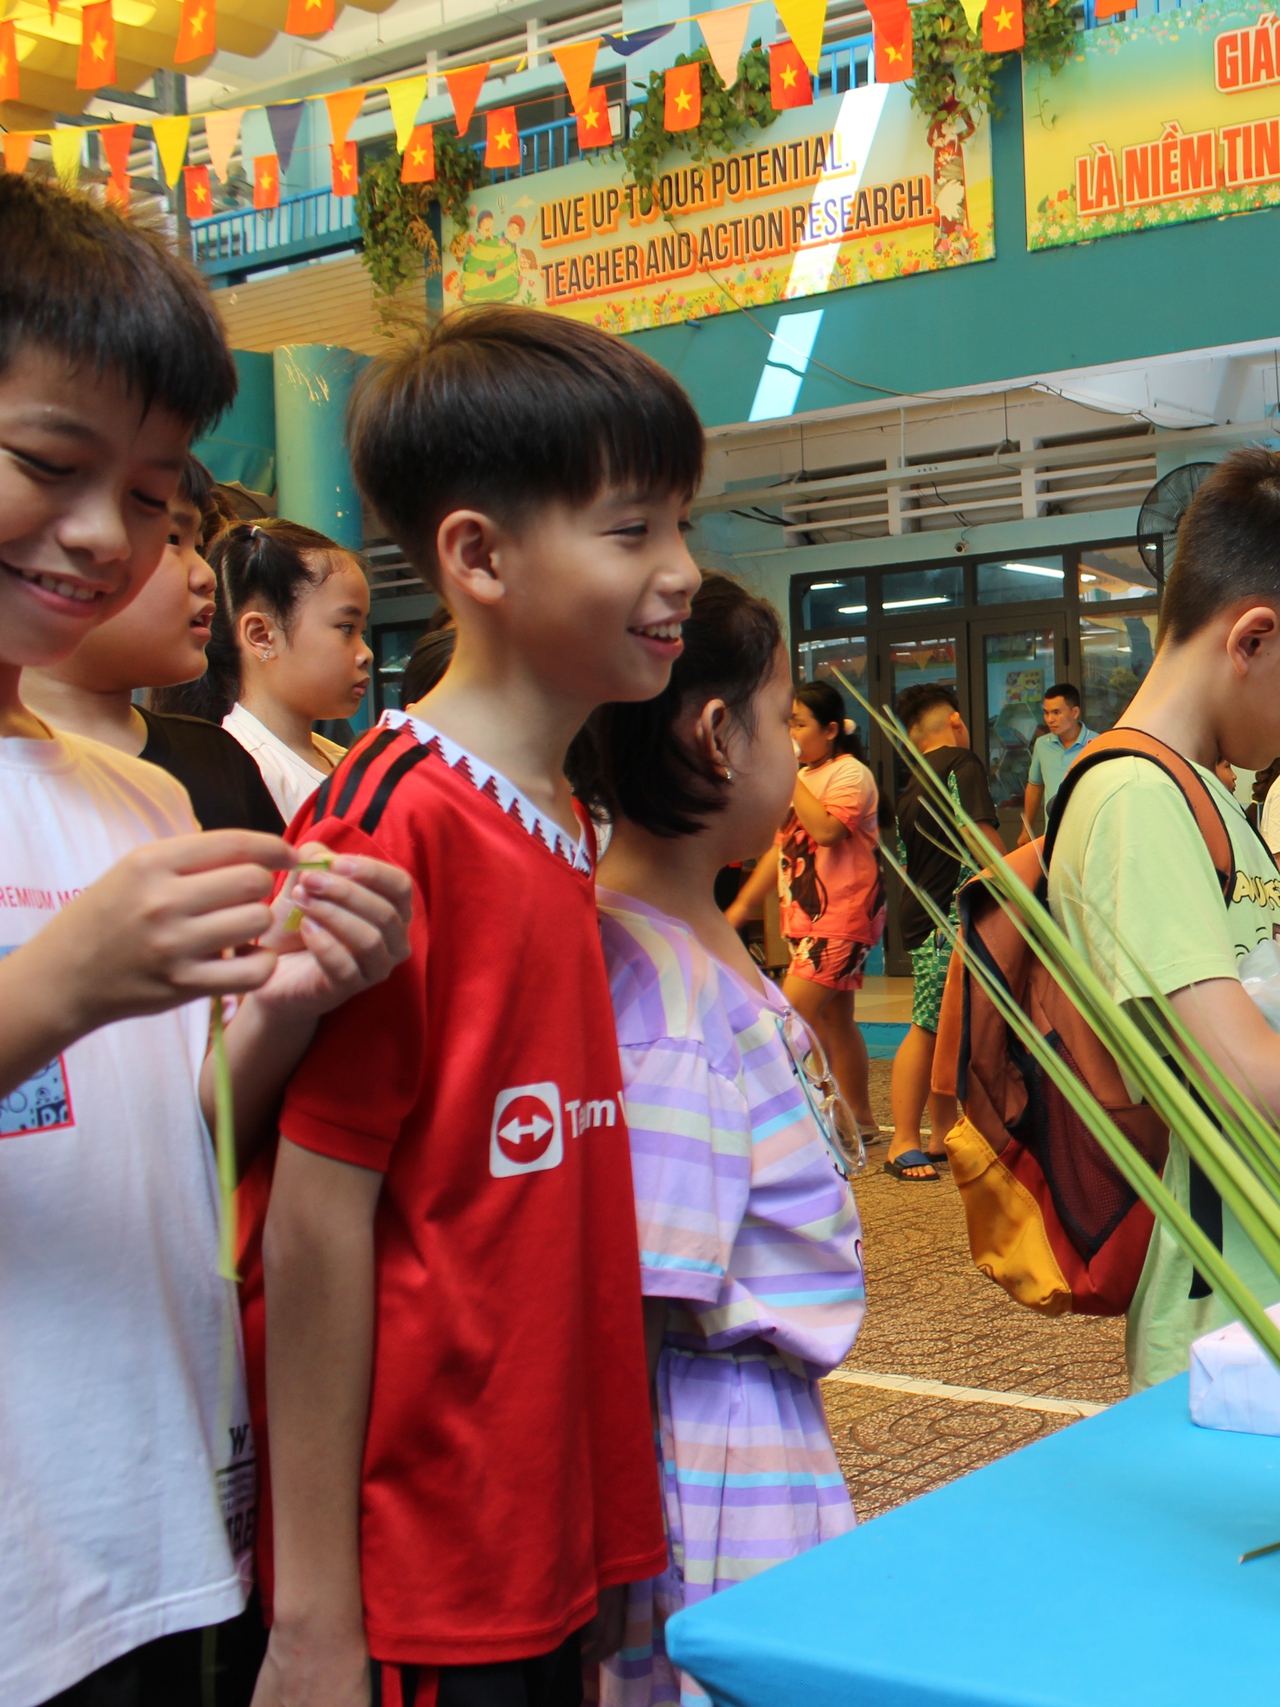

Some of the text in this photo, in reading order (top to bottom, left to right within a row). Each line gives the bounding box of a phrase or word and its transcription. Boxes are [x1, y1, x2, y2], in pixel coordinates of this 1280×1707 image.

[540, 195, 586, 243] LIVE
[591, 187, 620, 229] UP
[659, 166, 705, 212] OUR
[711, 132, 850, 200] POTENTIAL.
[1075, 141, 1120, 215] LÀ
[1122, 119, 1217, 207] NIỀM
[541, 177, 933, 300] TEACHER AND ACTION RESEARCH.
